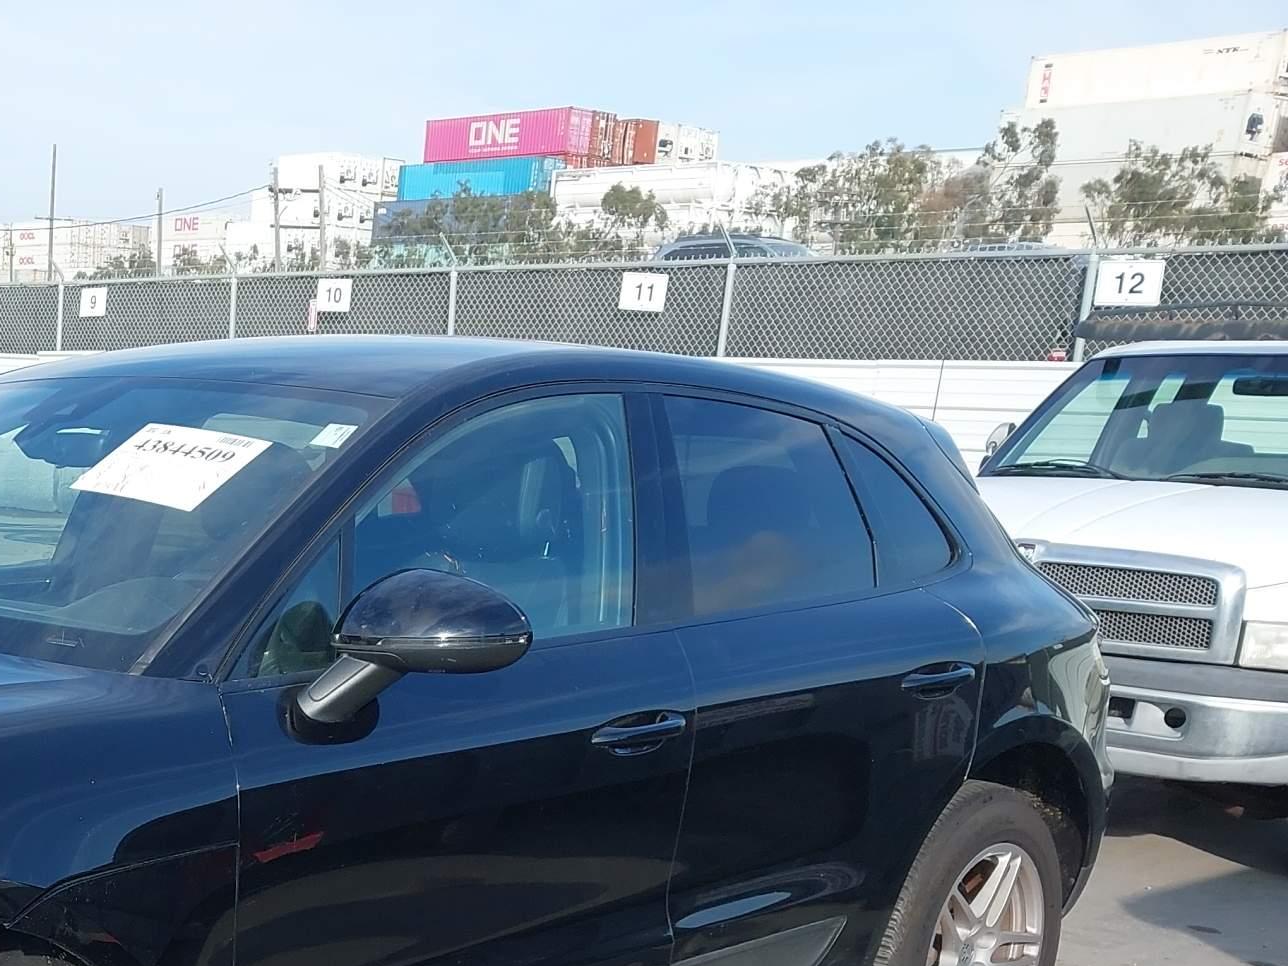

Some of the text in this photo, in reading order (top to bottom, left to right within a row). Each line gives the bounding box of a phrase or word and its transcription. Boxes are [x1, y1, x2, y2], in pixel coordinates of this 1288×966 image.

[469, 118, 520, 146] ONE
[174, 216, 199, 232] ONE
[635, 282, 654, 302] 11
[1115, 272, 1146, 294] 12
[90, 295, 97, 309] 9
[325, 287, 342, 303] 10
[134, 439, 236, 462] 43844509
